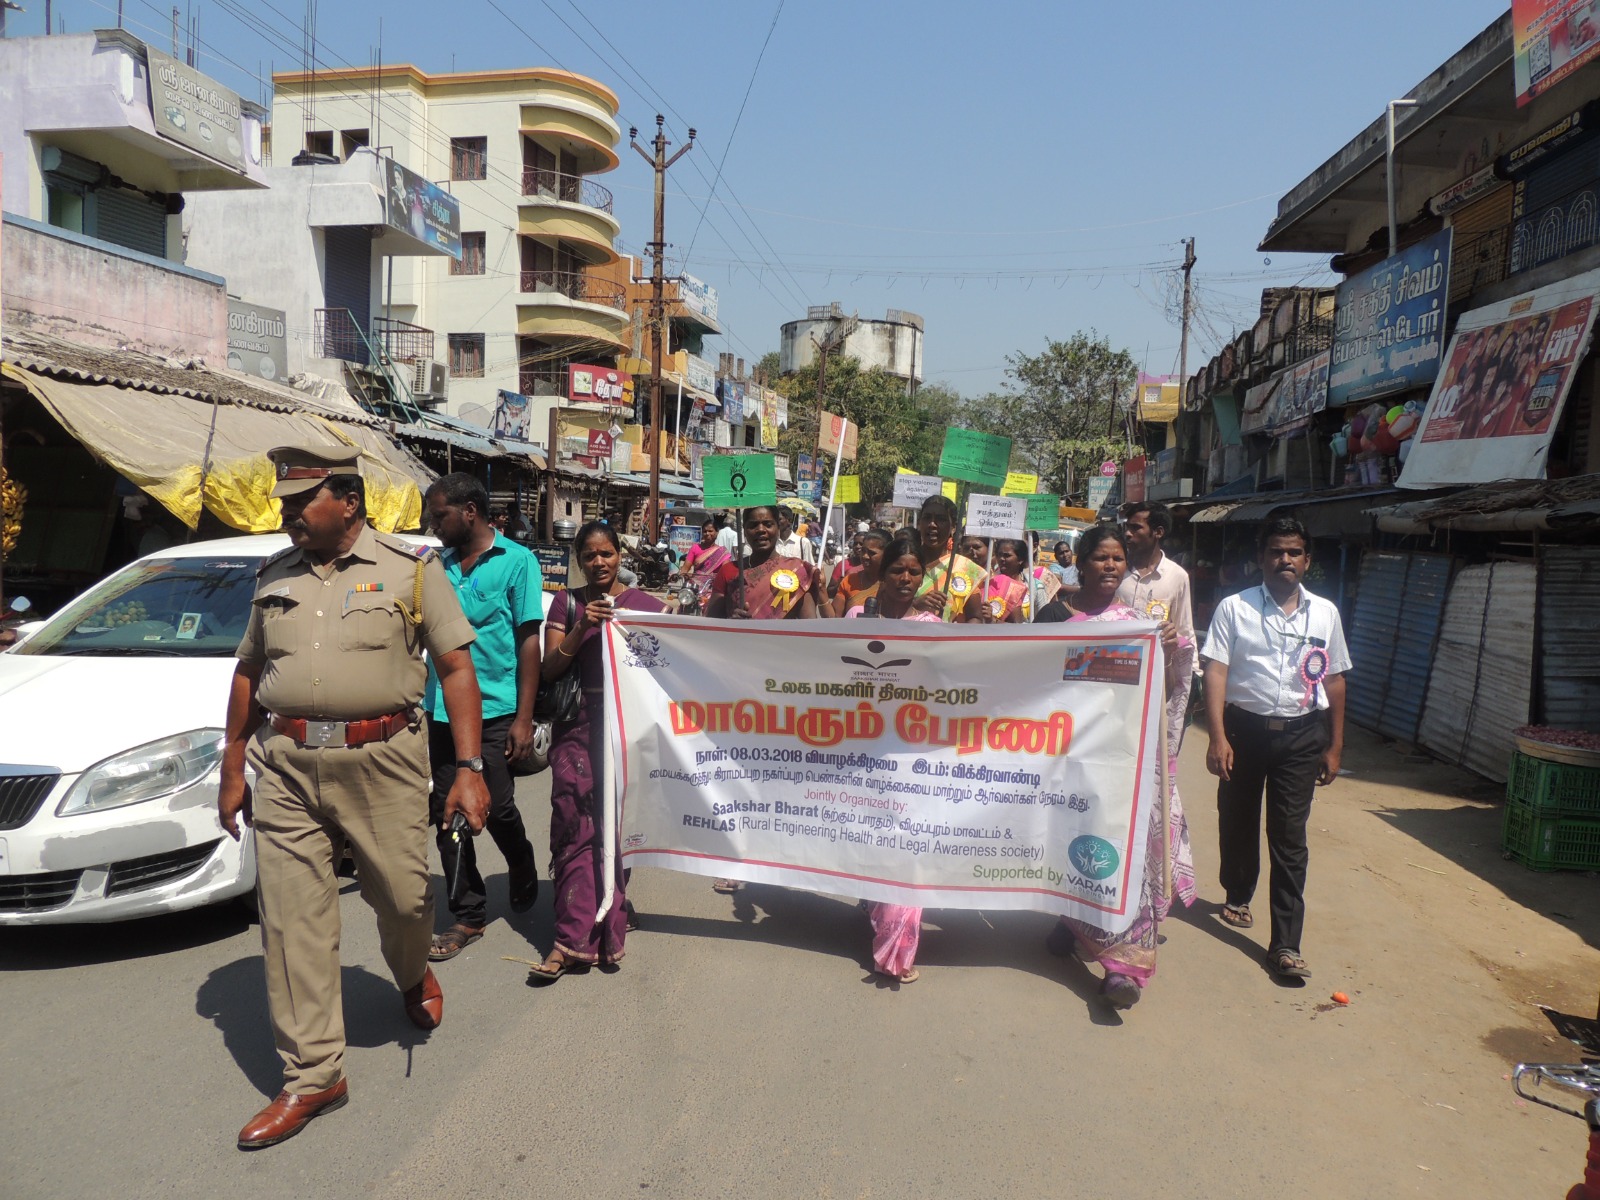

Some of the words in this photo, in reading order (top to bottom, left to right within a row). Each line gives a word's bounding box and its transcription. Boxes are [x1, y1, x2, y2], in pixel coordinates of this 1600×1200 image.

[193, 102, 235, 133] உணவகம்
[1358, 273, 1392, 321] சக்தி
[1394, 248, 1443, 305] சிவம்
[227, 310, 284, 338] னகிராம்
[1333, 324, 1374, 365] பேன்சி
[1376, 298, 1440, 350] ஸ்டோர்
[1550, 323, 1584, 341] FAMILY
[1542, 333, 1579, 363] HIT
[765, 678, 811, 694] உலக
[816, 681, 876, 698] மகளிர்
[878, 682, 979, 705] தினம்-2018
[668, 698, 885, 749] மாபெரும்
[894, 702, 1075, 757] பேரணி
[696, 747, 728, 765] நாள்:
[730, 748, 802, 762] 08.03.2018
[805, 750, 898, 773] வியாழக்கிழமை
[912, 758, 949, 776] இடம்:
[951, 763, 1041, 789] விக்கிரவாண்டி
[714, 765, 760, 782] கிராமப்புற
[762, 766, 803, 785] நகர்ப்புற
[806, 769, 864, 787] பெண்களின்
[866, 776, 931, 796] வாழ்க்கையை
[933, 785, 972, 802] மாற்றும்
[974, 788, 1038, 805] ஆர்வலர்கள்
[1038, 789, 1066, 807] நேரம்
[1067, 793, 1091, 812] இது.
[804, 788, 837, 803] Jointly
[839, 791, 890, 810] Organized
[892, 801, 909, 815] by:
[712, 800, 771, 816] Saakshar
[774, 801, 819, 818] Bharat
[821, 805, 856, 824] (கற்கும்
[858, 813, 896, 832] பாரதம்),
[899, 817, 950, 838] விழுப்புரம்
[953, 825, 1001, 840] மாவட்டம்
[1004, 828, 1013, 840] &
[682, 814, 736, 832] REHLAS
[738, 816, 771, 833] (Rural
[774, 818, 836, 842] Engineering
[839, 827, 873, 846] Health
[876, 835, 896, 849] and
[900, 836, 930, 855] Legal
[933, 840, 997, 857] Awareness
[1000, 844, 1045, 861] society)
[972, 865, 1043, 881] Supported
[1047, 867, 1063, 886] by
[1066, 874, 1117, 897] VARAM
